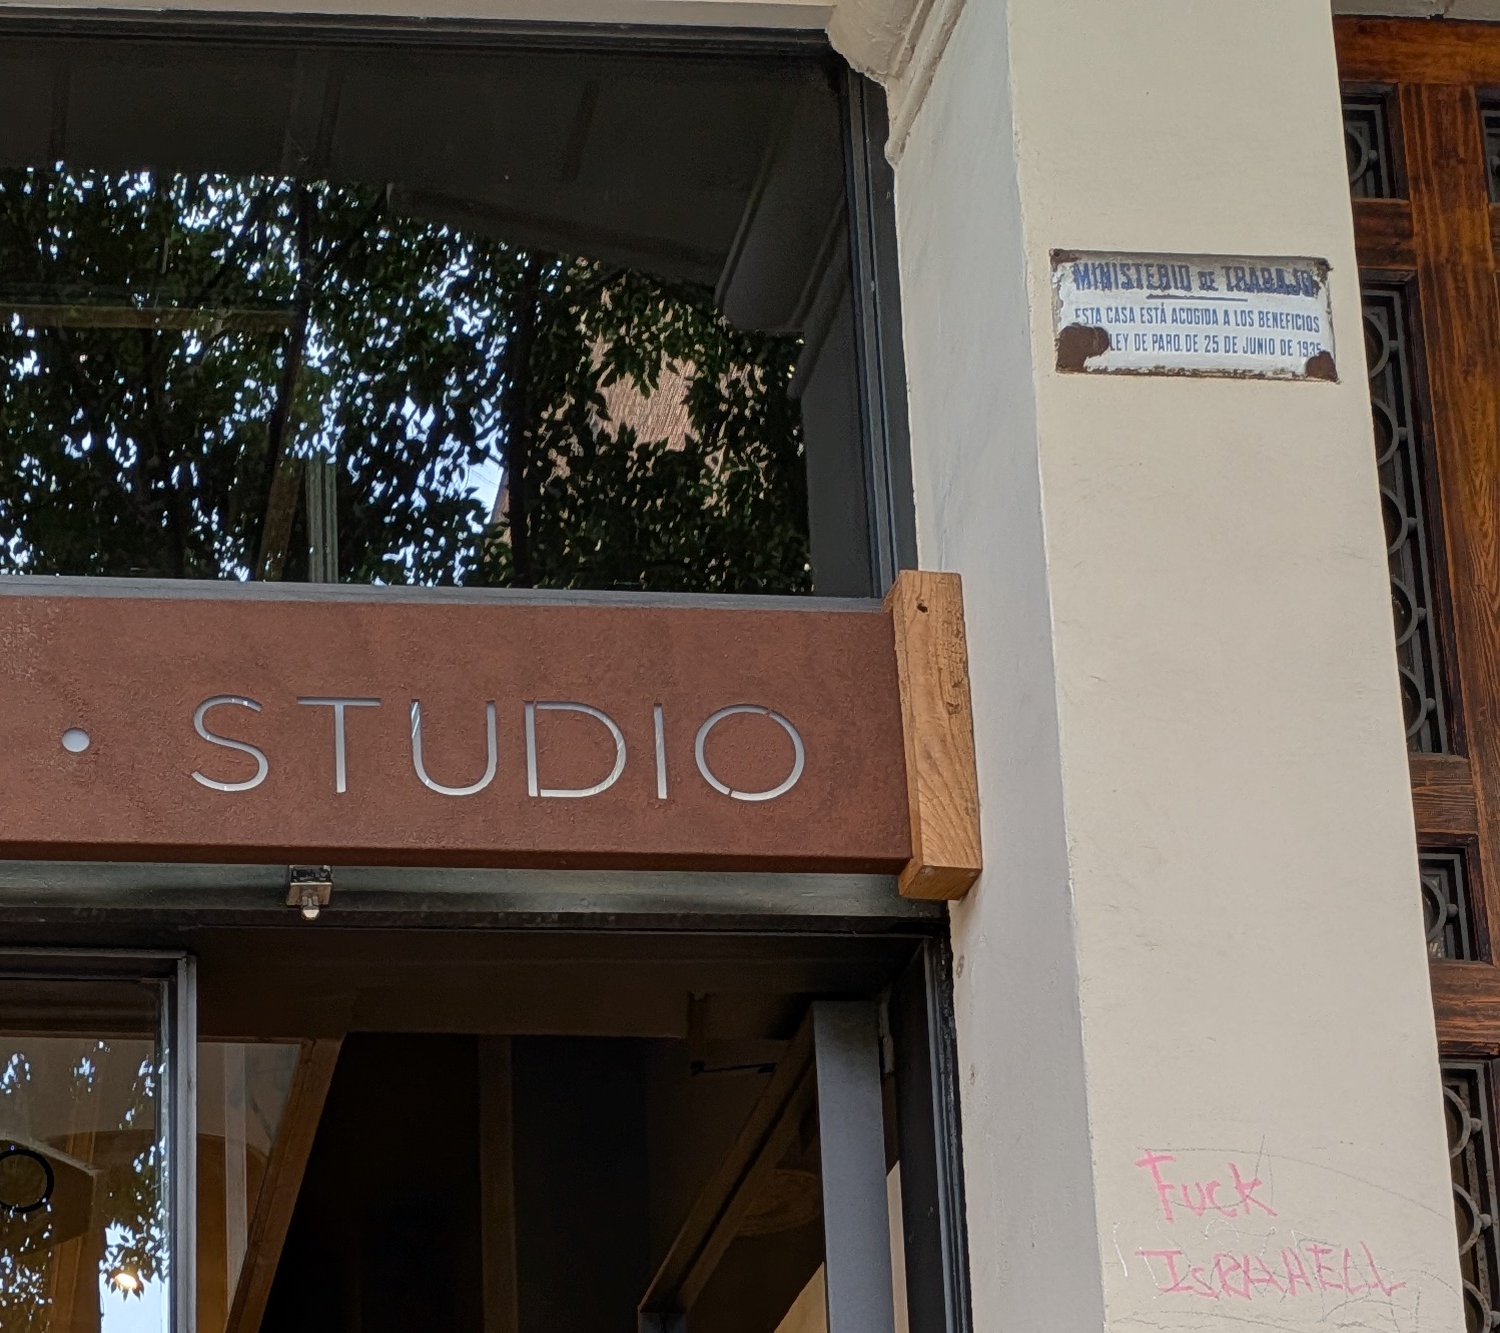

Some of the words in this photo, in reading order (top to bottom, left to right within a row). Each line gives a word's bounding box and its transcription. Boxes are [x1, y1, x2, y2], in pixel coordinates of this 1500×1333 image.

[1106, 306, 1136, 325] CASA
[1140, 302, 1167, 325] ESTÁ
[1171, 307, 1219, 327] ACOGIDA
[1223, 309, 1231, 327] A
[1234, 309, 1254, 328] LOS
[1258, 310, 1320, 334] BENEFICIOS
[1134, 333, 1148, 352] DE
[1185, 334, 1199, 353] DE
[1204, 335, 1219, 354] 25
[1224, 335, 1238, 354] DE
[1242, 337, 1276, 356] JUNIO
[1280, 338, 1294, 357] DE
[191, 693, 805, 802] STUDIO
[1134, 1149, 1277, 1221] Fuck
